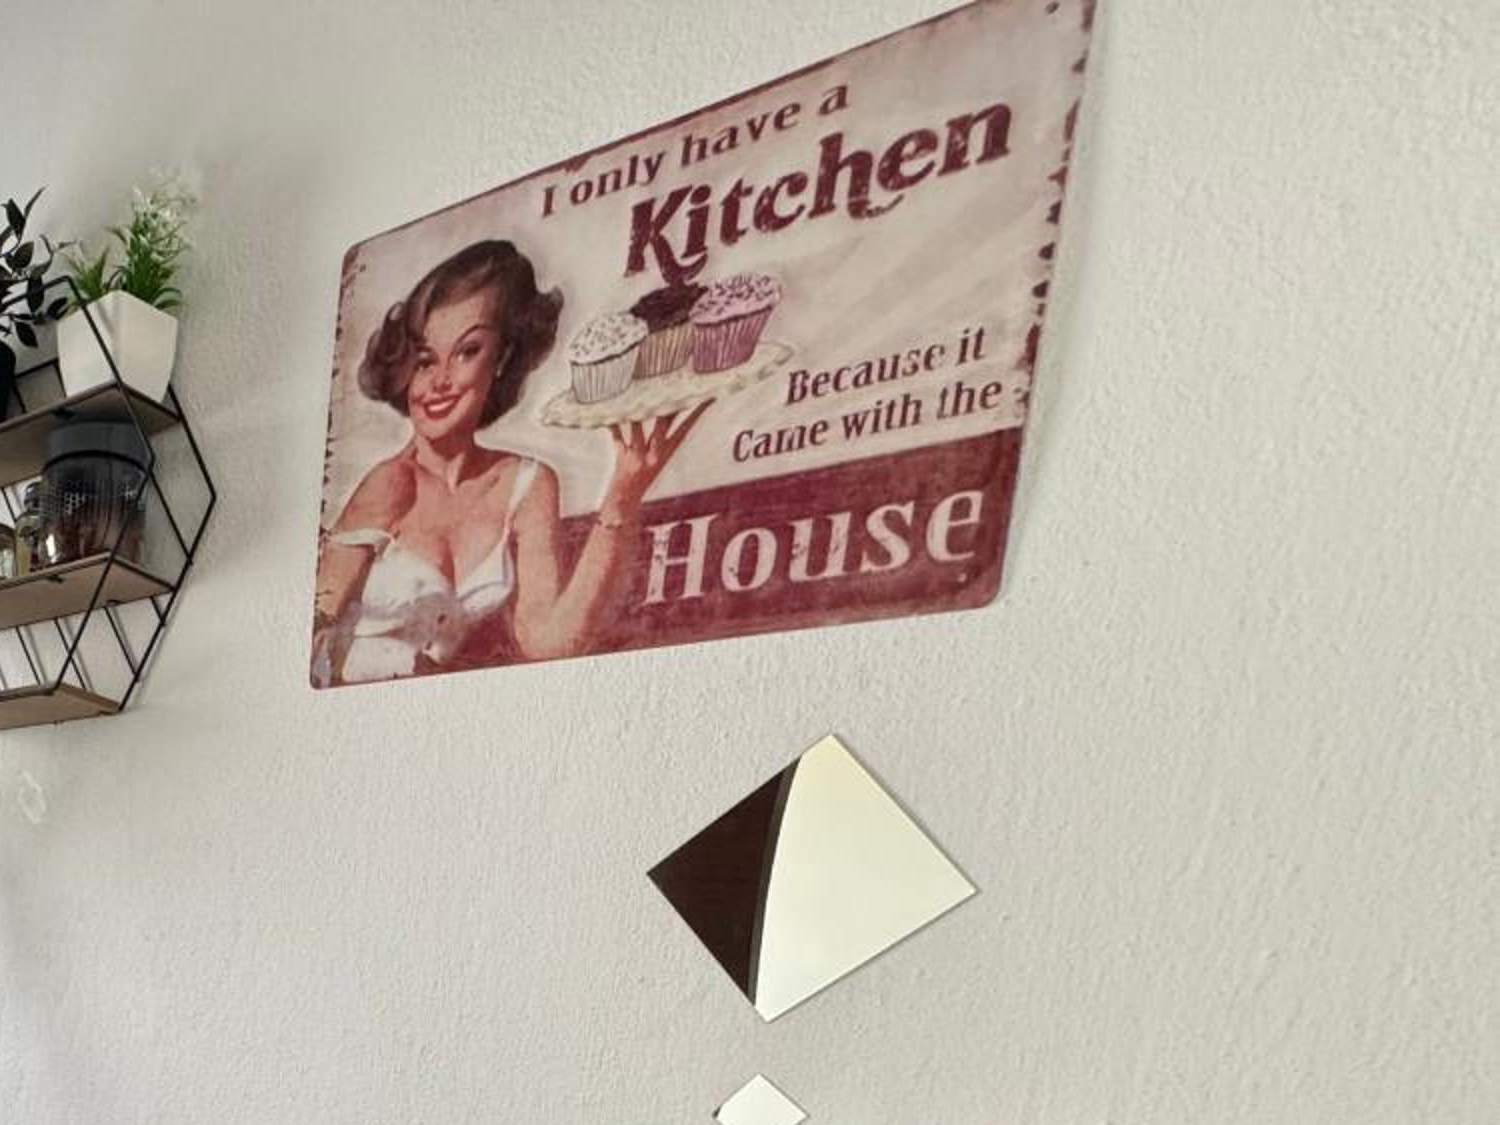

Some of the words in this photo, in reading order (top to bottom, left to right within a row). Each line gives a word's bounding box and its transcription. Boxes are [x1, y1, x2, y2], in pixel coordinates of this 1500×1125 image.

[542, 186, 557, 217] I
[569, 151, 665, 206] only
[681, 103, 801, 168] have
[818, 84, 848, 115] a
[623, 103, 1012, 285] Kitchen
[732, 419, 829, 462] Came
[841, 393, 922, 441] with
[936, 380, 1003, 420] the
[786, 344, 945, 405] Because
[956, 326, 986, 365] it
[642, 489, 984, 606] House
